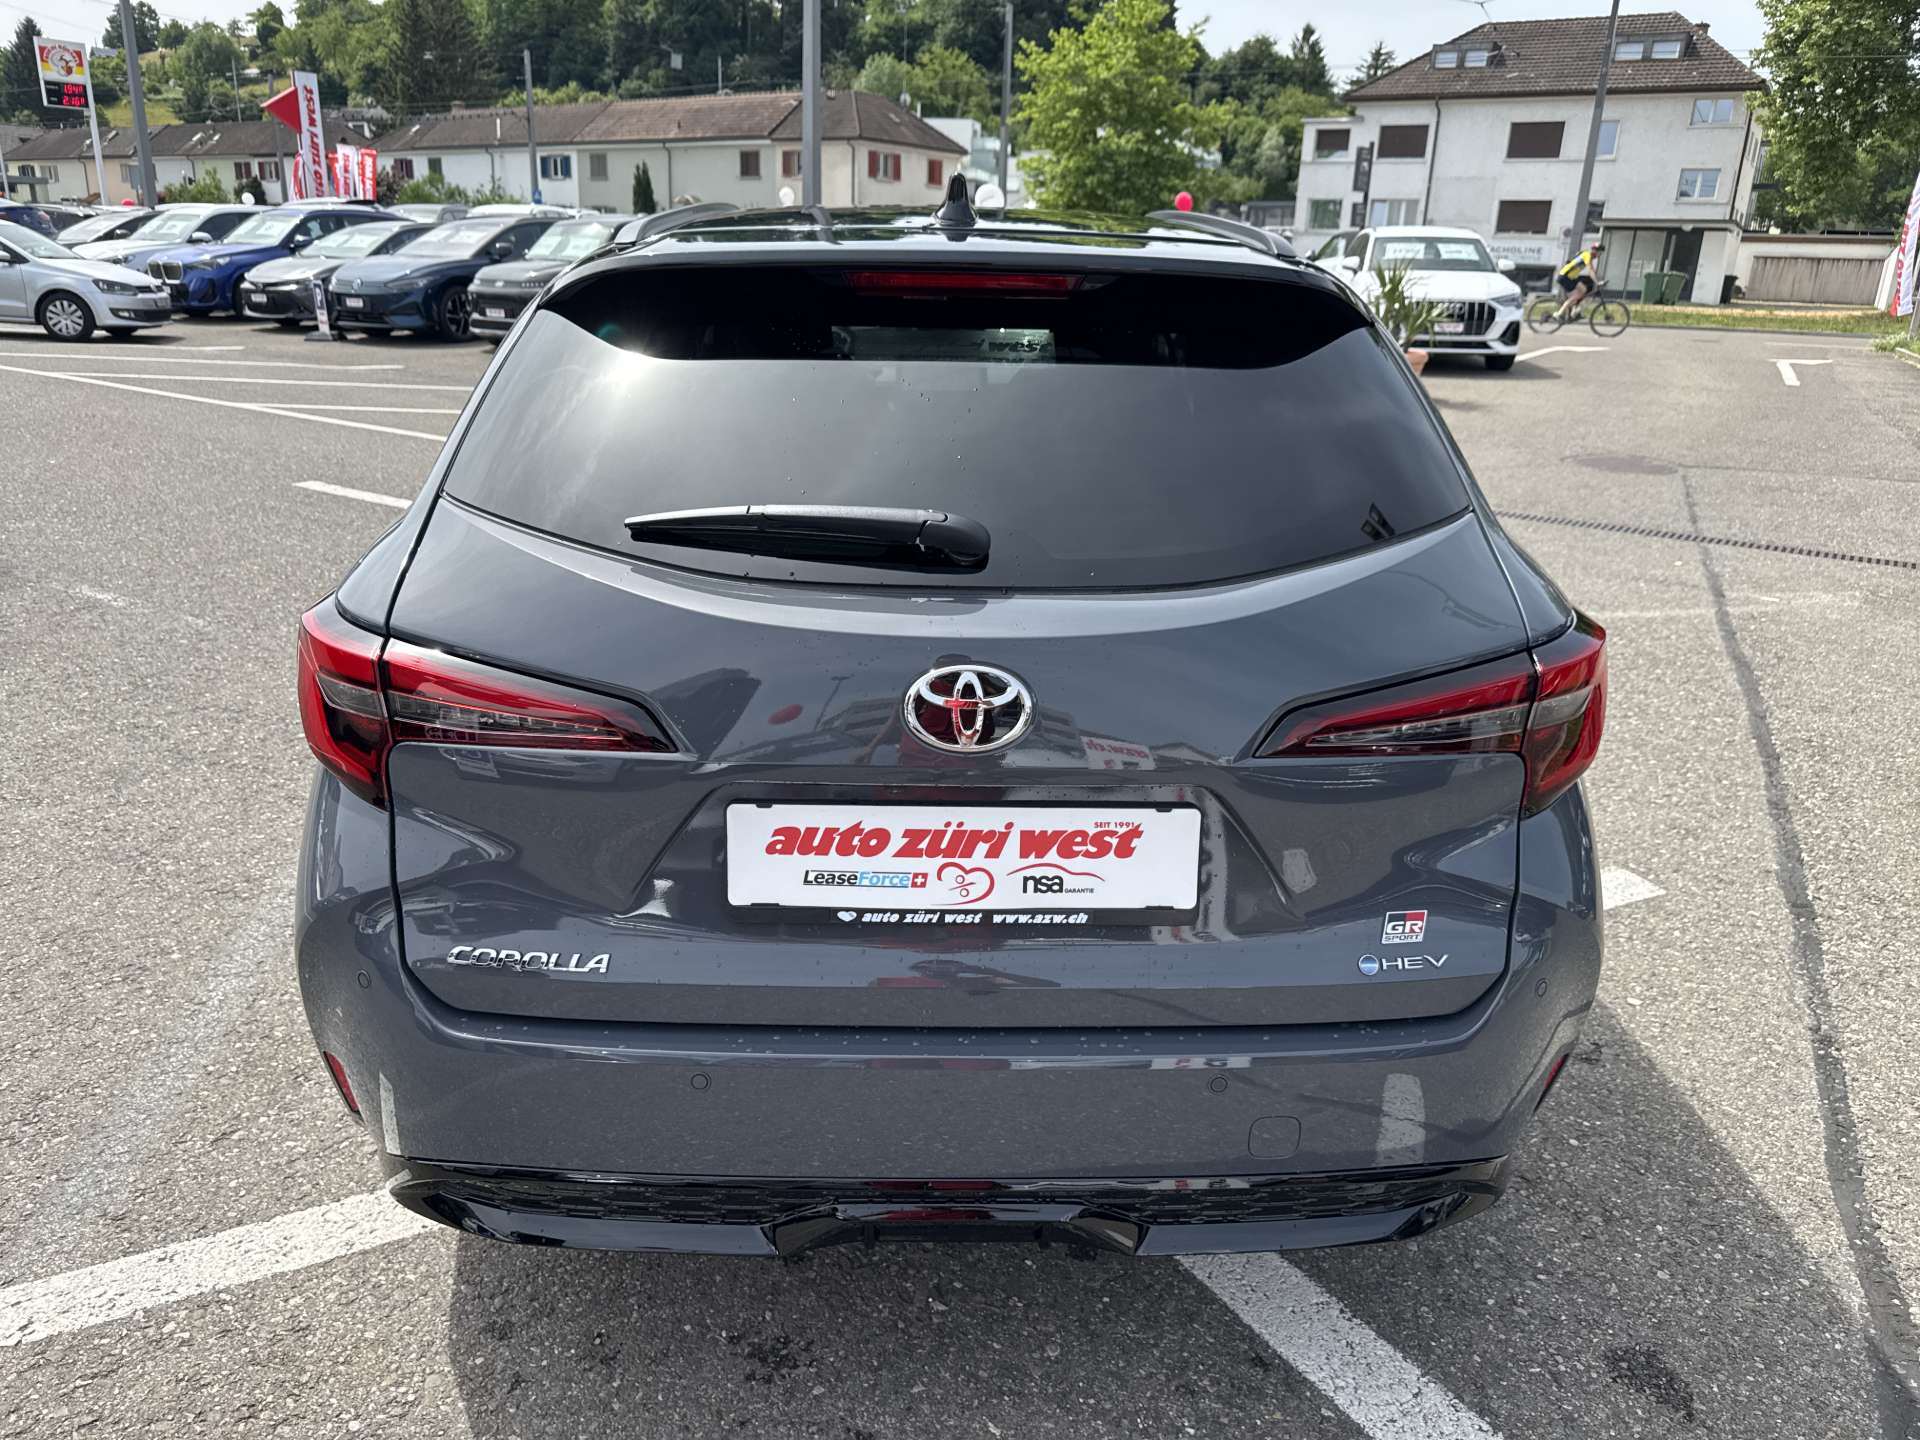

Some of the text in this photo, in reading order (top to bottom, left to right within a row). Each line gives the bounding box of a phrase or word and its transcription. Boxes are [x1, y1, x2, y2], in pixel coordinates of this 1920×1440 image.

[303, 85, 317, 127] west
[1094, 821, 1135, 829] SEIT 1991
[765, 820, 1144, 859] auto züri west
[803, 870, 911, 887] LeaseForce
[1022, 875, 1064, 894] nsa
[861, 911, 1089, 924] auto züri west www.azw.ch
[1386, 921, 1423, 934] GR
[1384, 934, 1420, 942] SPORT
[446, 945, 612, 973] COROLLA
[1381, 955, 1449, 970] HEV
